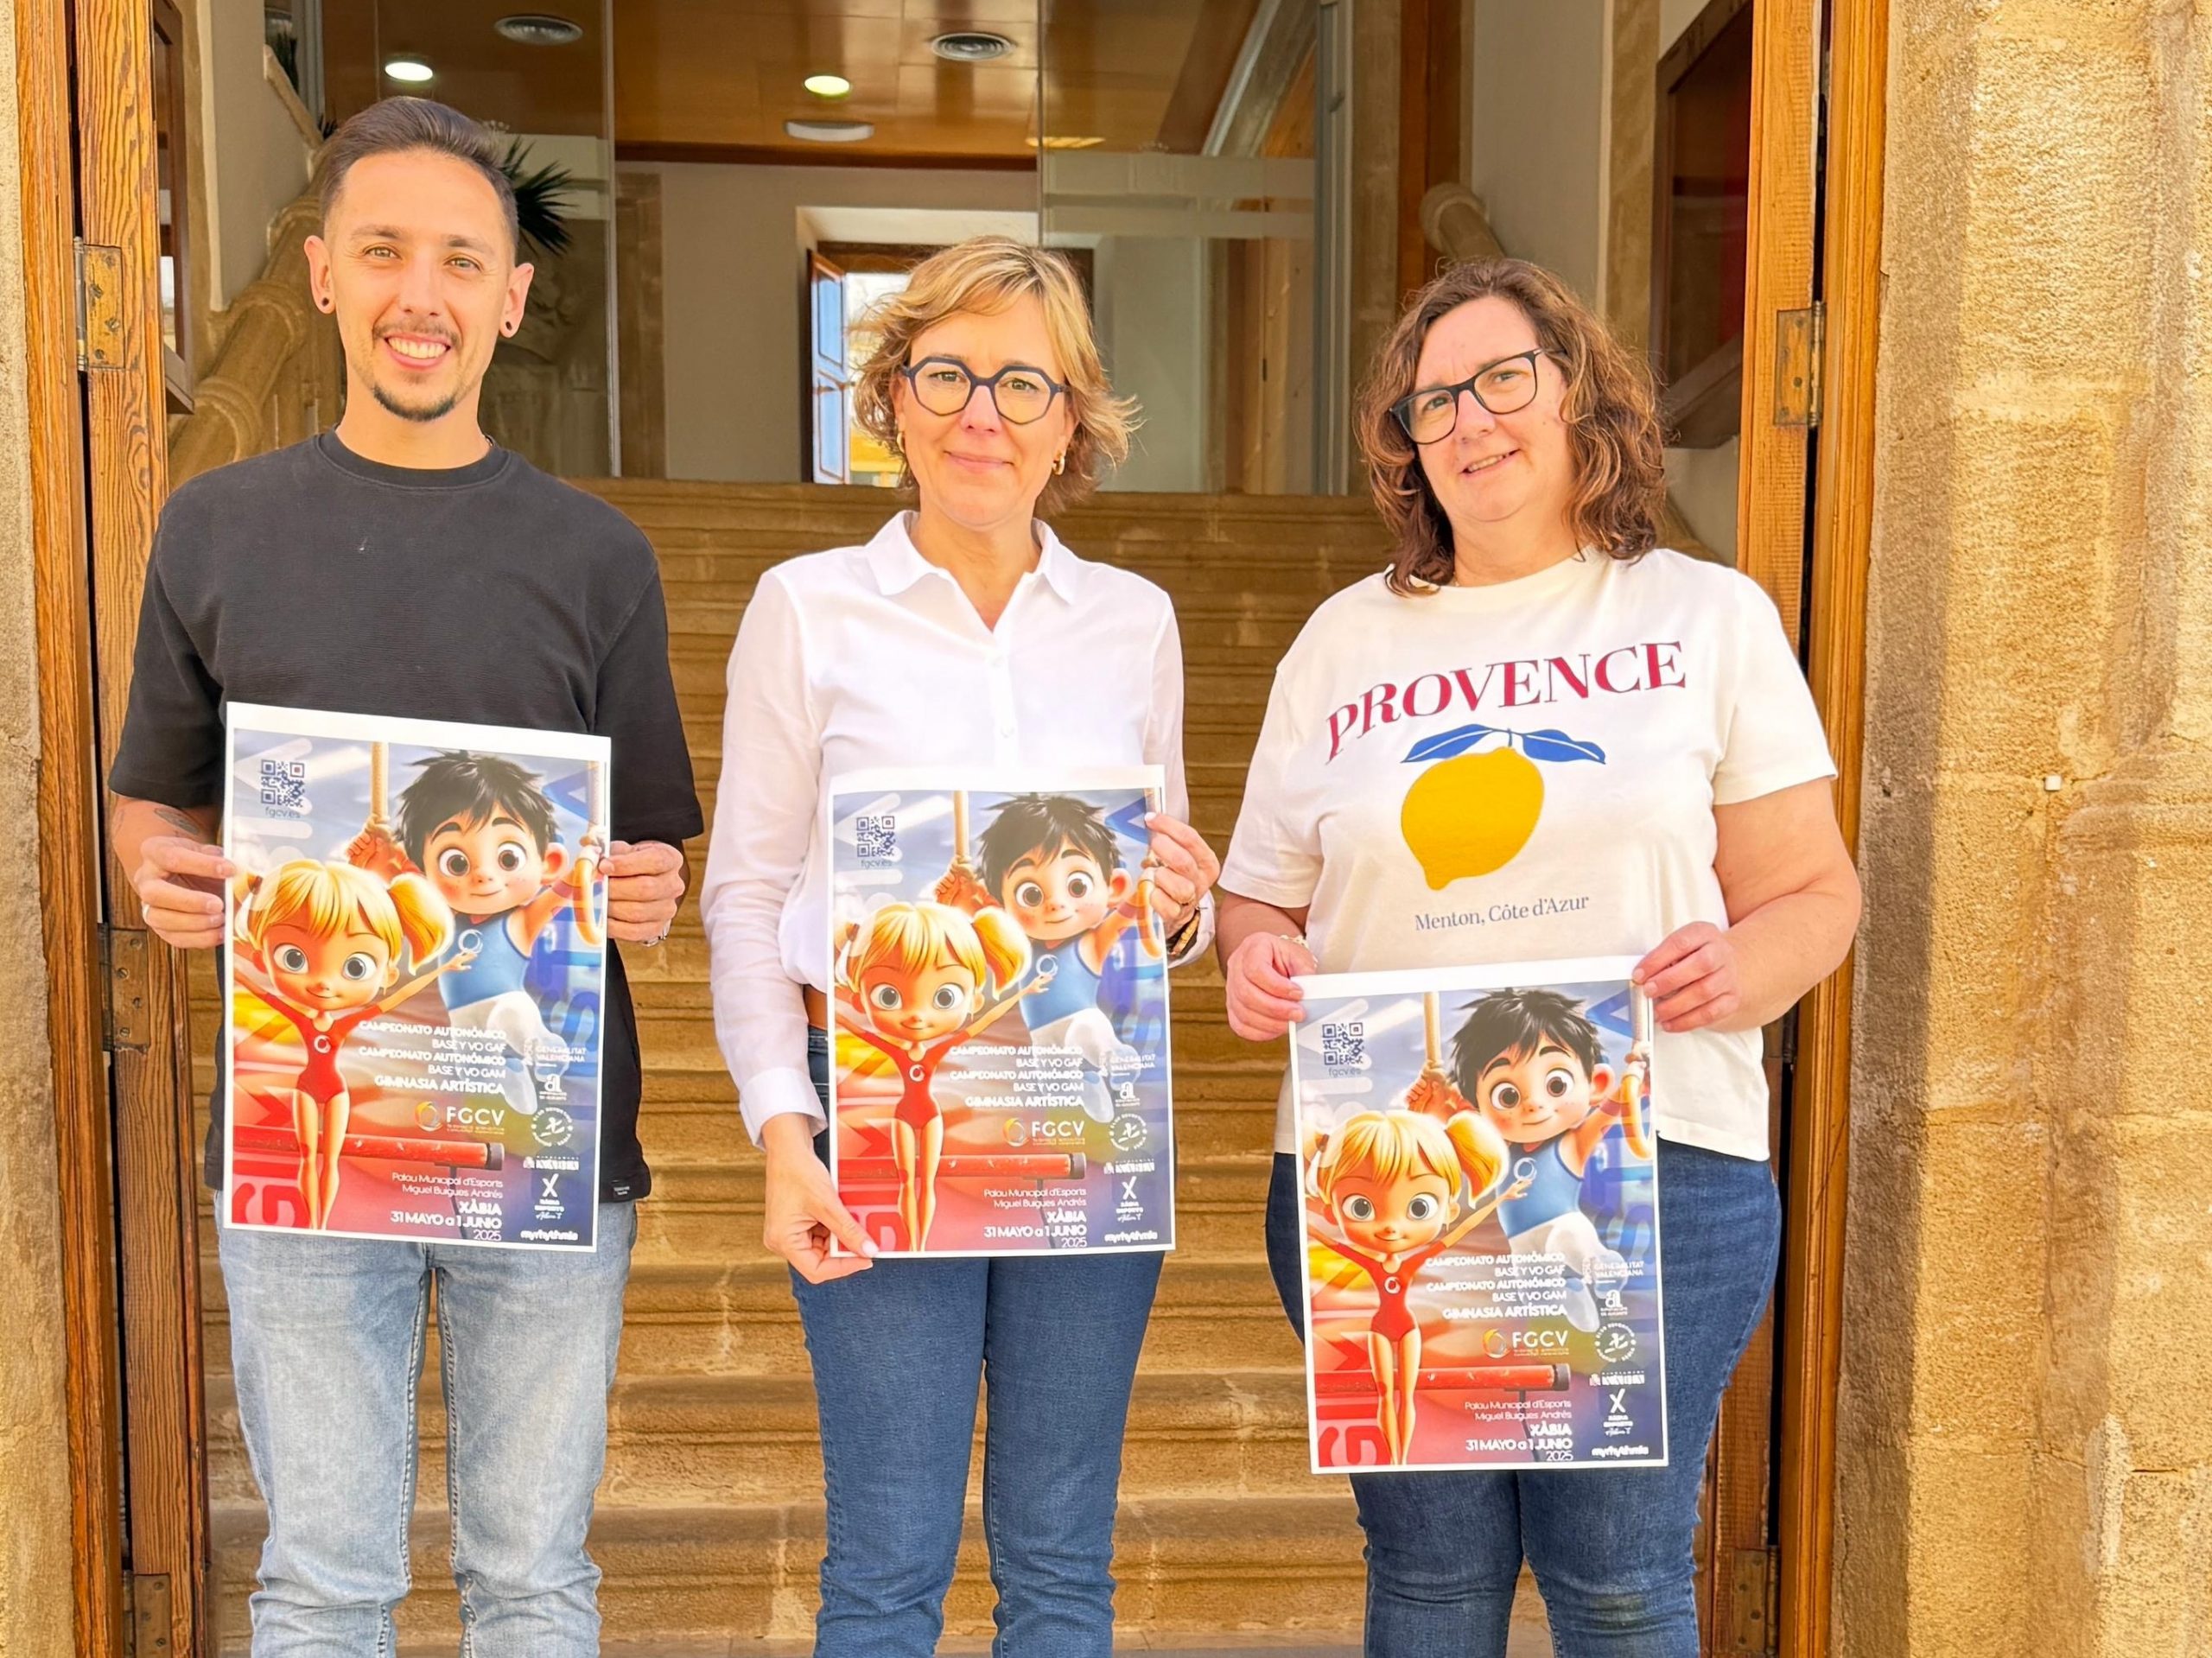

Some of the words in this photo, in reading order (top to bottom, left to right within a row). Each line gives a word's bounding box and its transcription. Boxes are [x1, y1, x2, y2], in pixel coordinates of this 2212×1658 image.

[1325, 640, 1687, 765] PROVENCE
[1414, 909, 1485, 931] Menton,
[1489, 904, 1529, 923] Côte
[1533, 894, 1590, 916] d'Azur
[359, 1020, 432, 1035] CAMPEONATO
[434, 1026, 506, 1039] AUTONÓMICO
[433, 1039, 457, 1049] BASE
[457, 1041, 467, 1050] Y
[467, 1042, 483, 1051] VO
[485, 1043, 506, 1052] GAF
[950, 1045, 1016, 1055] CAMPEONATO
[1017, 1044, 1083, 1055] AUTONÓMICO
[359, 1046, 431, 1061] CAMPEONATO
[434, 1051, 506, 1066] AUTONÓMICO
[1016, 1058, 1039, 1068] BASE
[1039, 1058, 1048, 1067] Y
[1048, 1058, 1063, 1067] VO
[1064, 1058, 1083, 1067] GAF
[429, 1064, 453, 1075] BASE
[455, 1066, 464, 1076] Y
[465, 1067, 479, 1077] VO
[480, 1068, 505, 1079] GAM
[950, 1070, 1016, 1080] CAMPEONATO
[1018, 1068, 1084, 1079] AUTONÓMICO
[375, 1075, 438, 1090] GIMNASIA
[441, 1078, 505, 1094] ARTÍSTICA
[1013, 1083, 1037, 1092] BASE
[1038, 1083, 1046, 1091] Y
[1046, 1083, 1058, 1091] VO
[1061, 1083, 1084, 1091] GAM
[964, 1096, 1024, 1107] GIMNASIA
[1025, 1094, 1084, 1107] ARTÍSTICA
[447, 1106, 505, 1126] FGCV
[1032, 1121, 1084, 1137] FGCV
[392, 1172, 417, 1182] Palau
[402, 1185, 432, 1195] Miguel
[471, 1188, 503, 1198] Andrés
[983, 1188, 1007, 1197] Palau
[994, 1199, 1021, 1209] Miguel
[1057, 1197, 1087, 1207] Andrés
[391, 1210, 404, 1223] 31
[405, 1213, 444, 1226] MAYO
[474, 1229, 501, 1241] 2025
[983, 1226, 995, 1237] 31
[997, 1225, 1033, 1237] MAYO
[1061, 1237, 1087, 1248] 2025
[1427, 1255, 1494, 1267] CAMPEONATO
[1496, 1251, 1565, 1264] AUTONÓMICO
[1494, 1267, 1519, 1277] BASE
[1520, 1267, 1529, 1275] Y
[1529, 1266, 1543, 1275] VO
[1545, 1265, 1566, 1274] GAF
[1427, 1280, 1495, 1292] CAMPEONATO
[1497, 1277, 1566, 1289] AUTONÓMICO
[1492, 1293, 1516, 1302] BASE
[1518, 1292, 1527, 1301] Y
[1528, 1292, 1541, 1301] VO
[1542, 1291, 1567, 1300] GAM
[1442, 1306, 1503, 1319] GIMNASIA
[1505, 1302, 1567, 1318] ARTÍSTICA
[1512, 1330, 1568, 1348] FGCV
[1465, 1401, 1489, 1410] Palau
[1475, 1412, 1503, 1422] Miguel
[1541, 1410, 1572, 1419] Andrés
[1465, 1439, 1478, 1451] 31
[1479, 1439, 1516, 1451] MAYO
[1546, 1451, 1573, 1461] 2025
